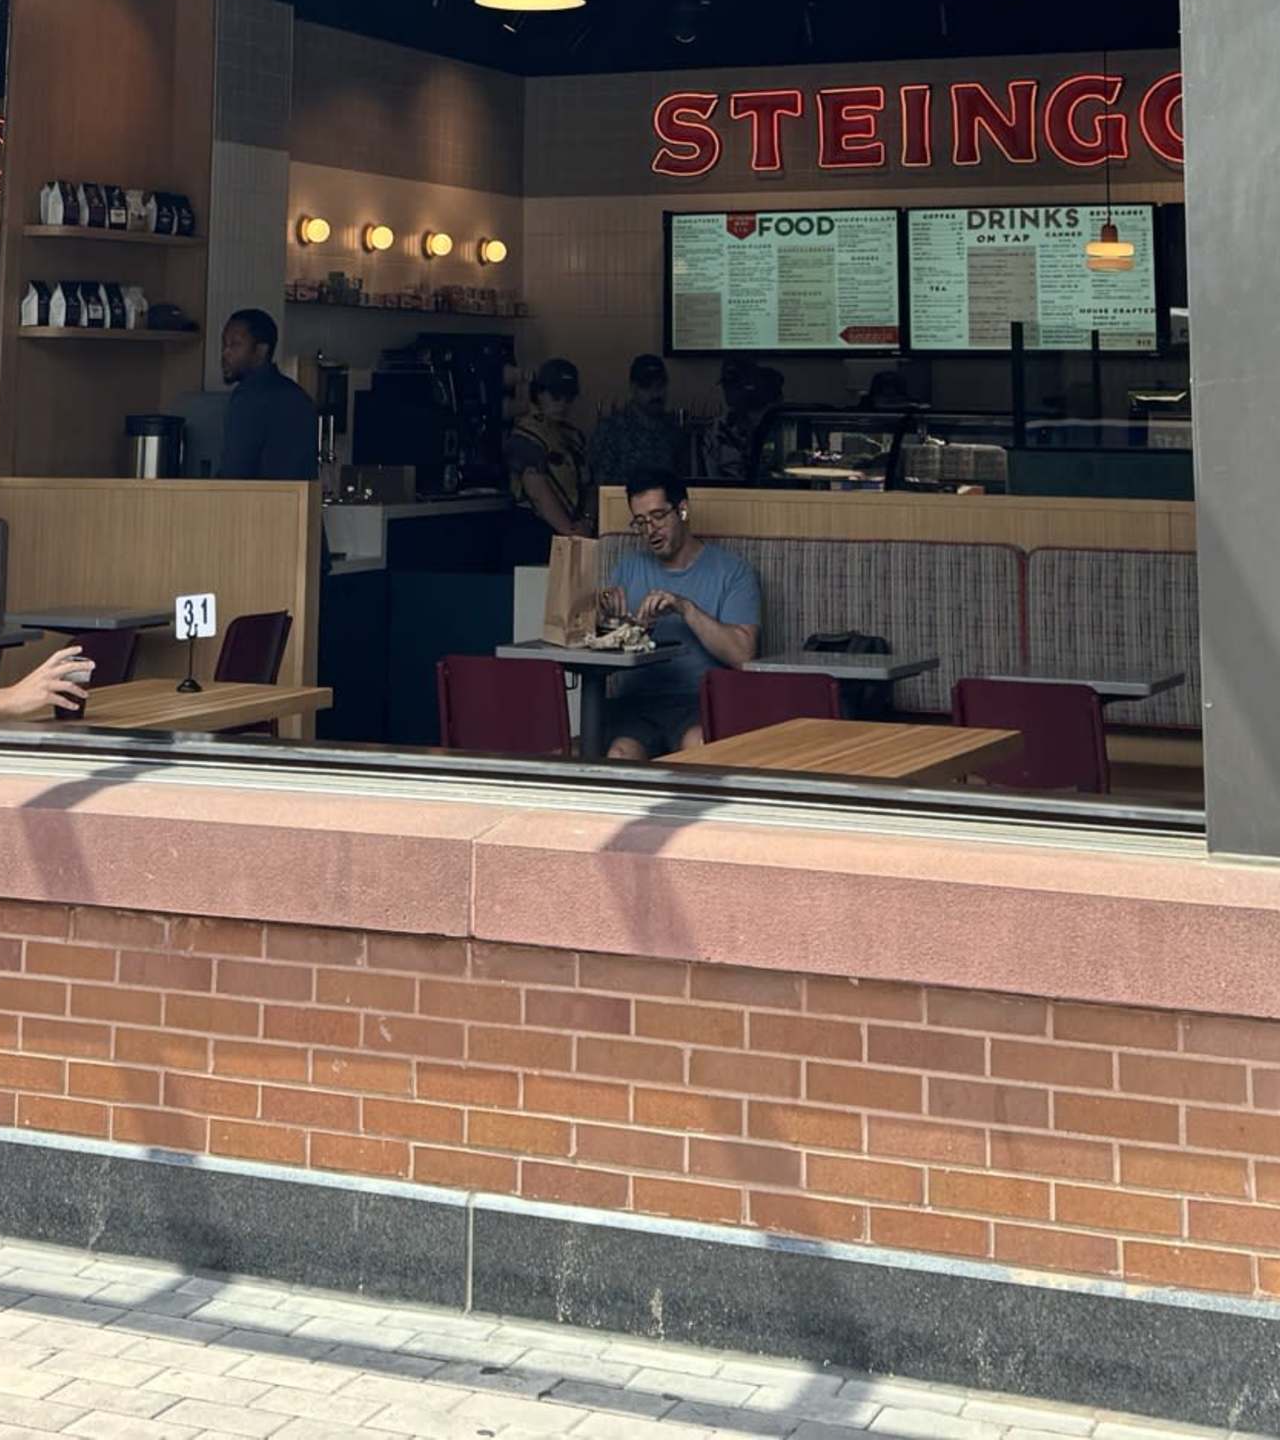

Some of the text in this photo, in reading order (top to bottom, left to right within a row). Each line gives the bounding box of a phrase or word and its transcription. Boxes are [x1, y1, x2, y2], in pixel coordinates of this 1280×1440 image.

[758, 216, 835, 237] FOOD
[967, 209, 1080, 230] DRINKS
[977, 233, 1031, 243] ON TAP
[183, 597, 208, 626] 31
